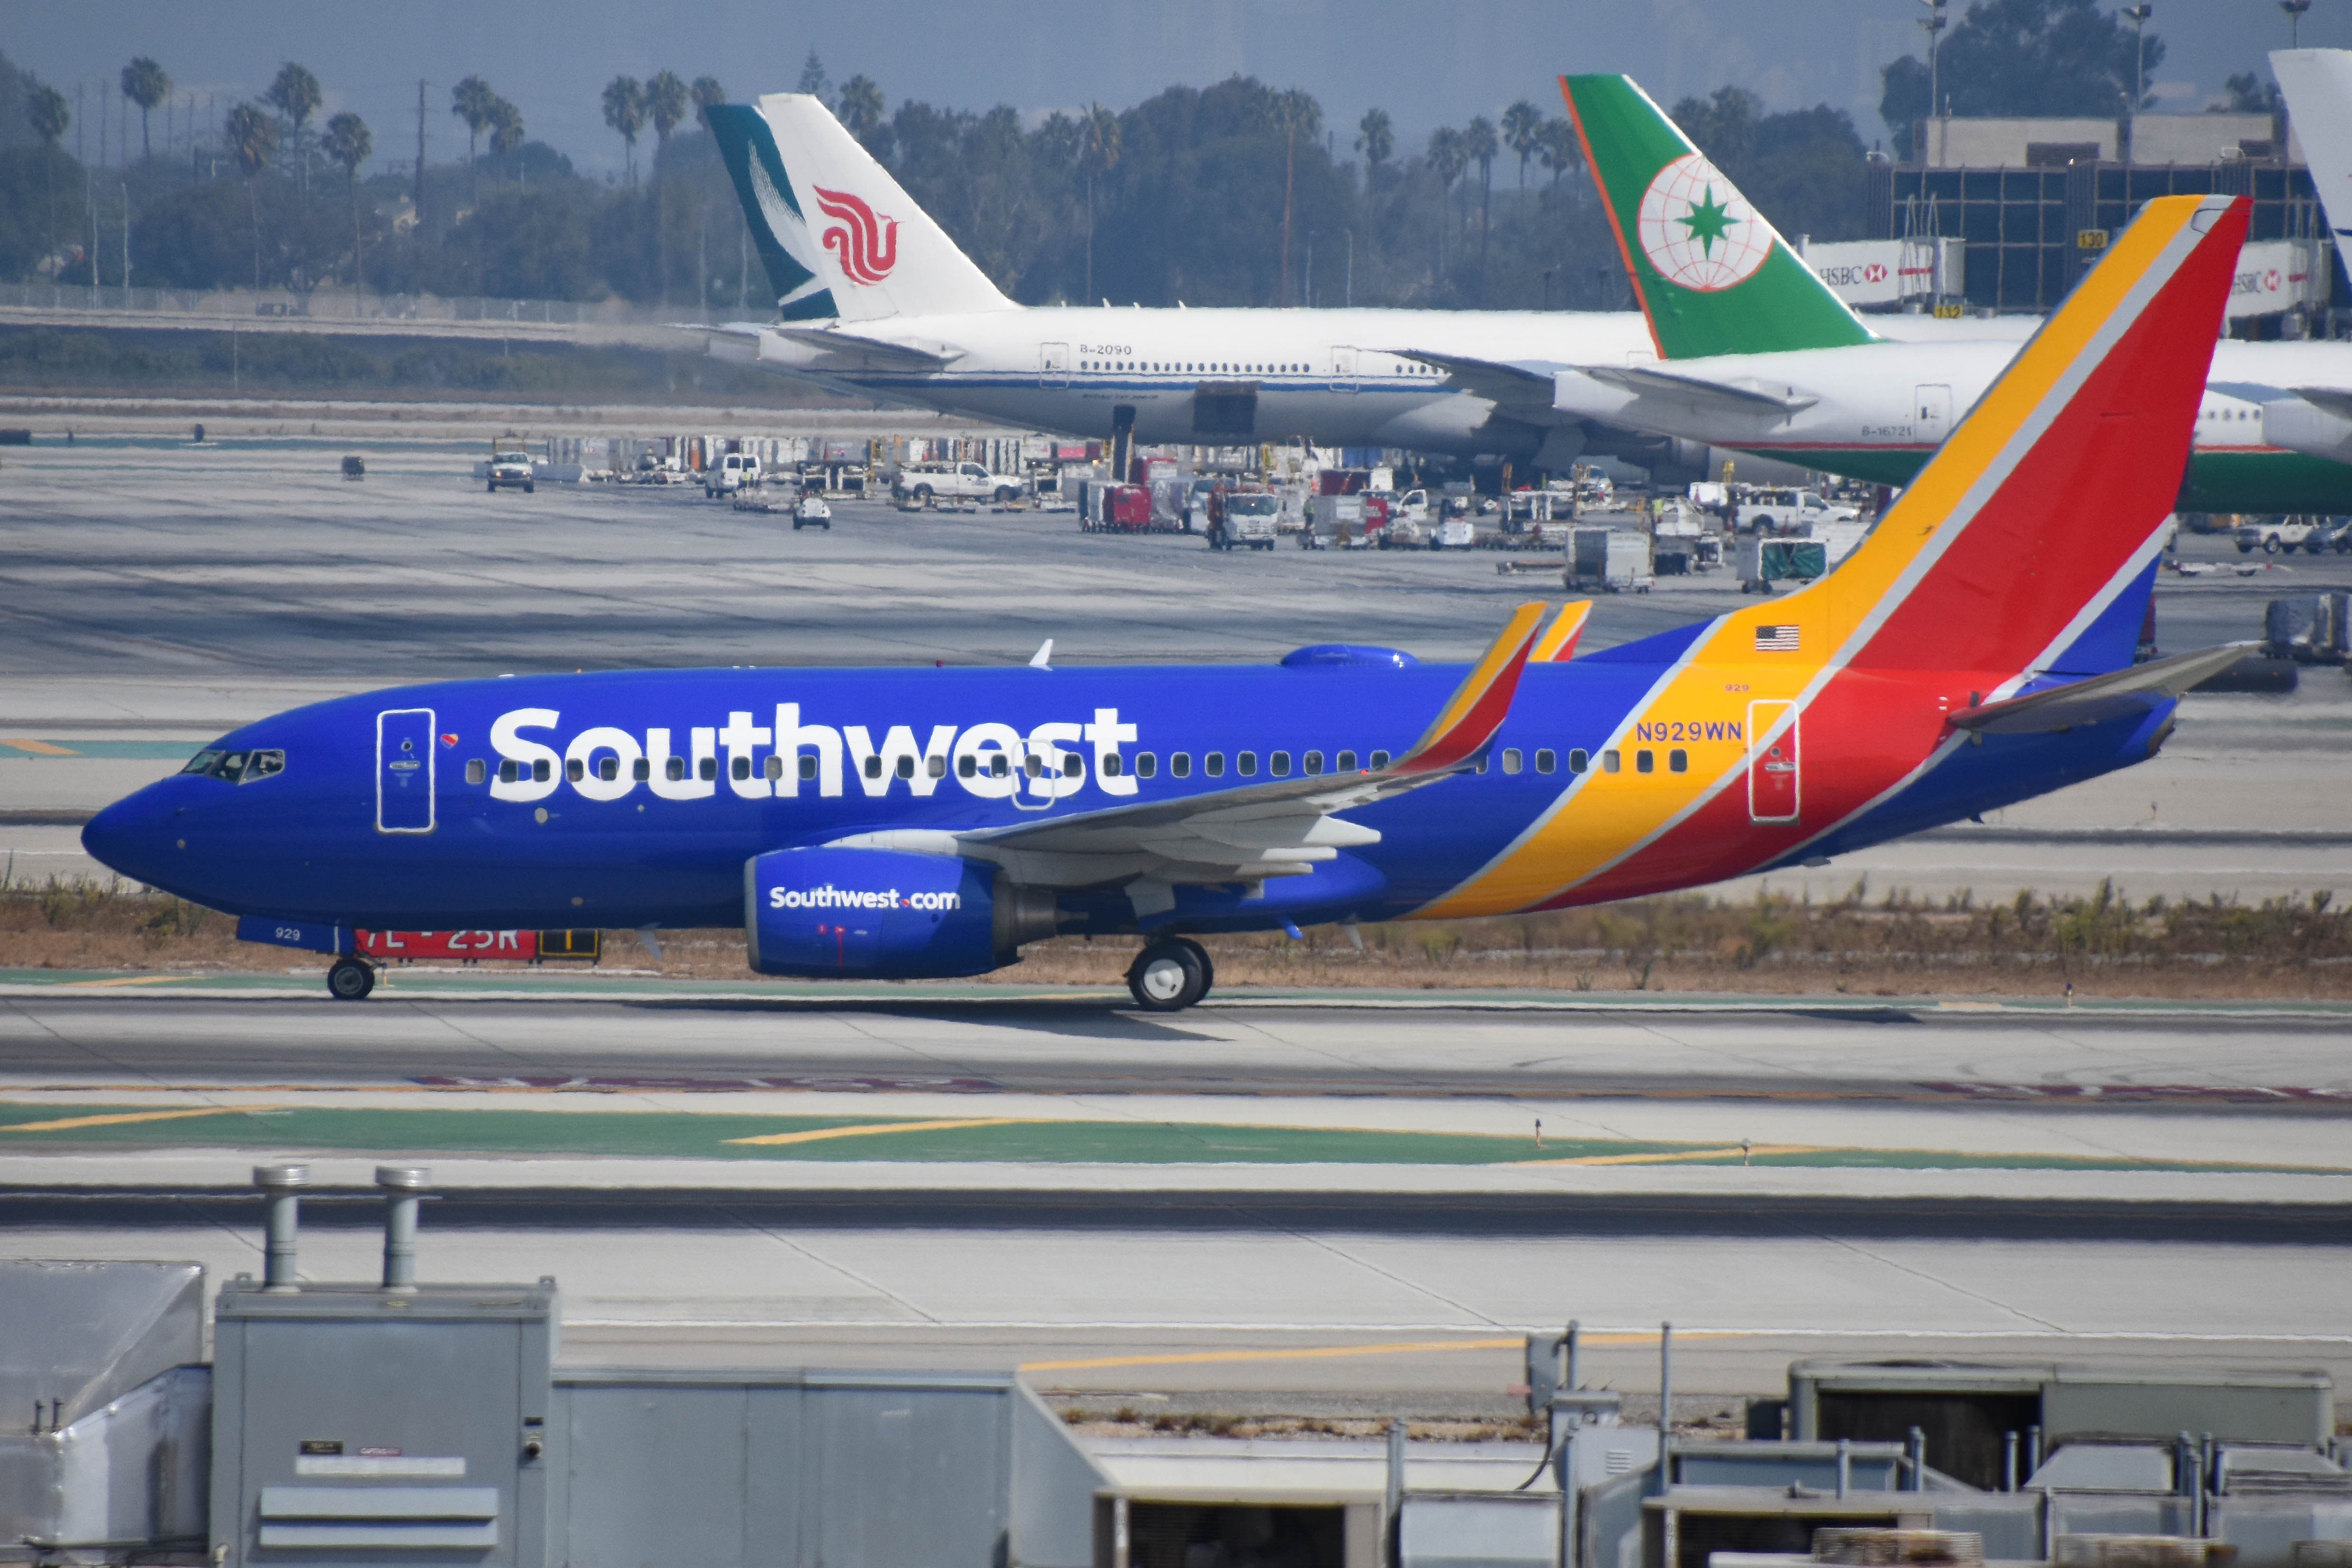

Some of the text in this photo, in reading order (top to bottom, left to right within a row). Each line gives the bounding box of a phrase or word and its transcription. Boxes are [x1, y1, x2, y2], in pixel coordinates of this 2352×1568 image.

[2081, 232, 2104, 247] 130
[1820, 266, 1862, 286] HSBC
[1080, 344, 1132, 355] B-2090
[1862, 425, 1911, 436] B-16721
[1636, 721, 1742, 741] N929WN
[489, 702, 1137, 802] Southwest
[276, 927, 300, 941] 929
